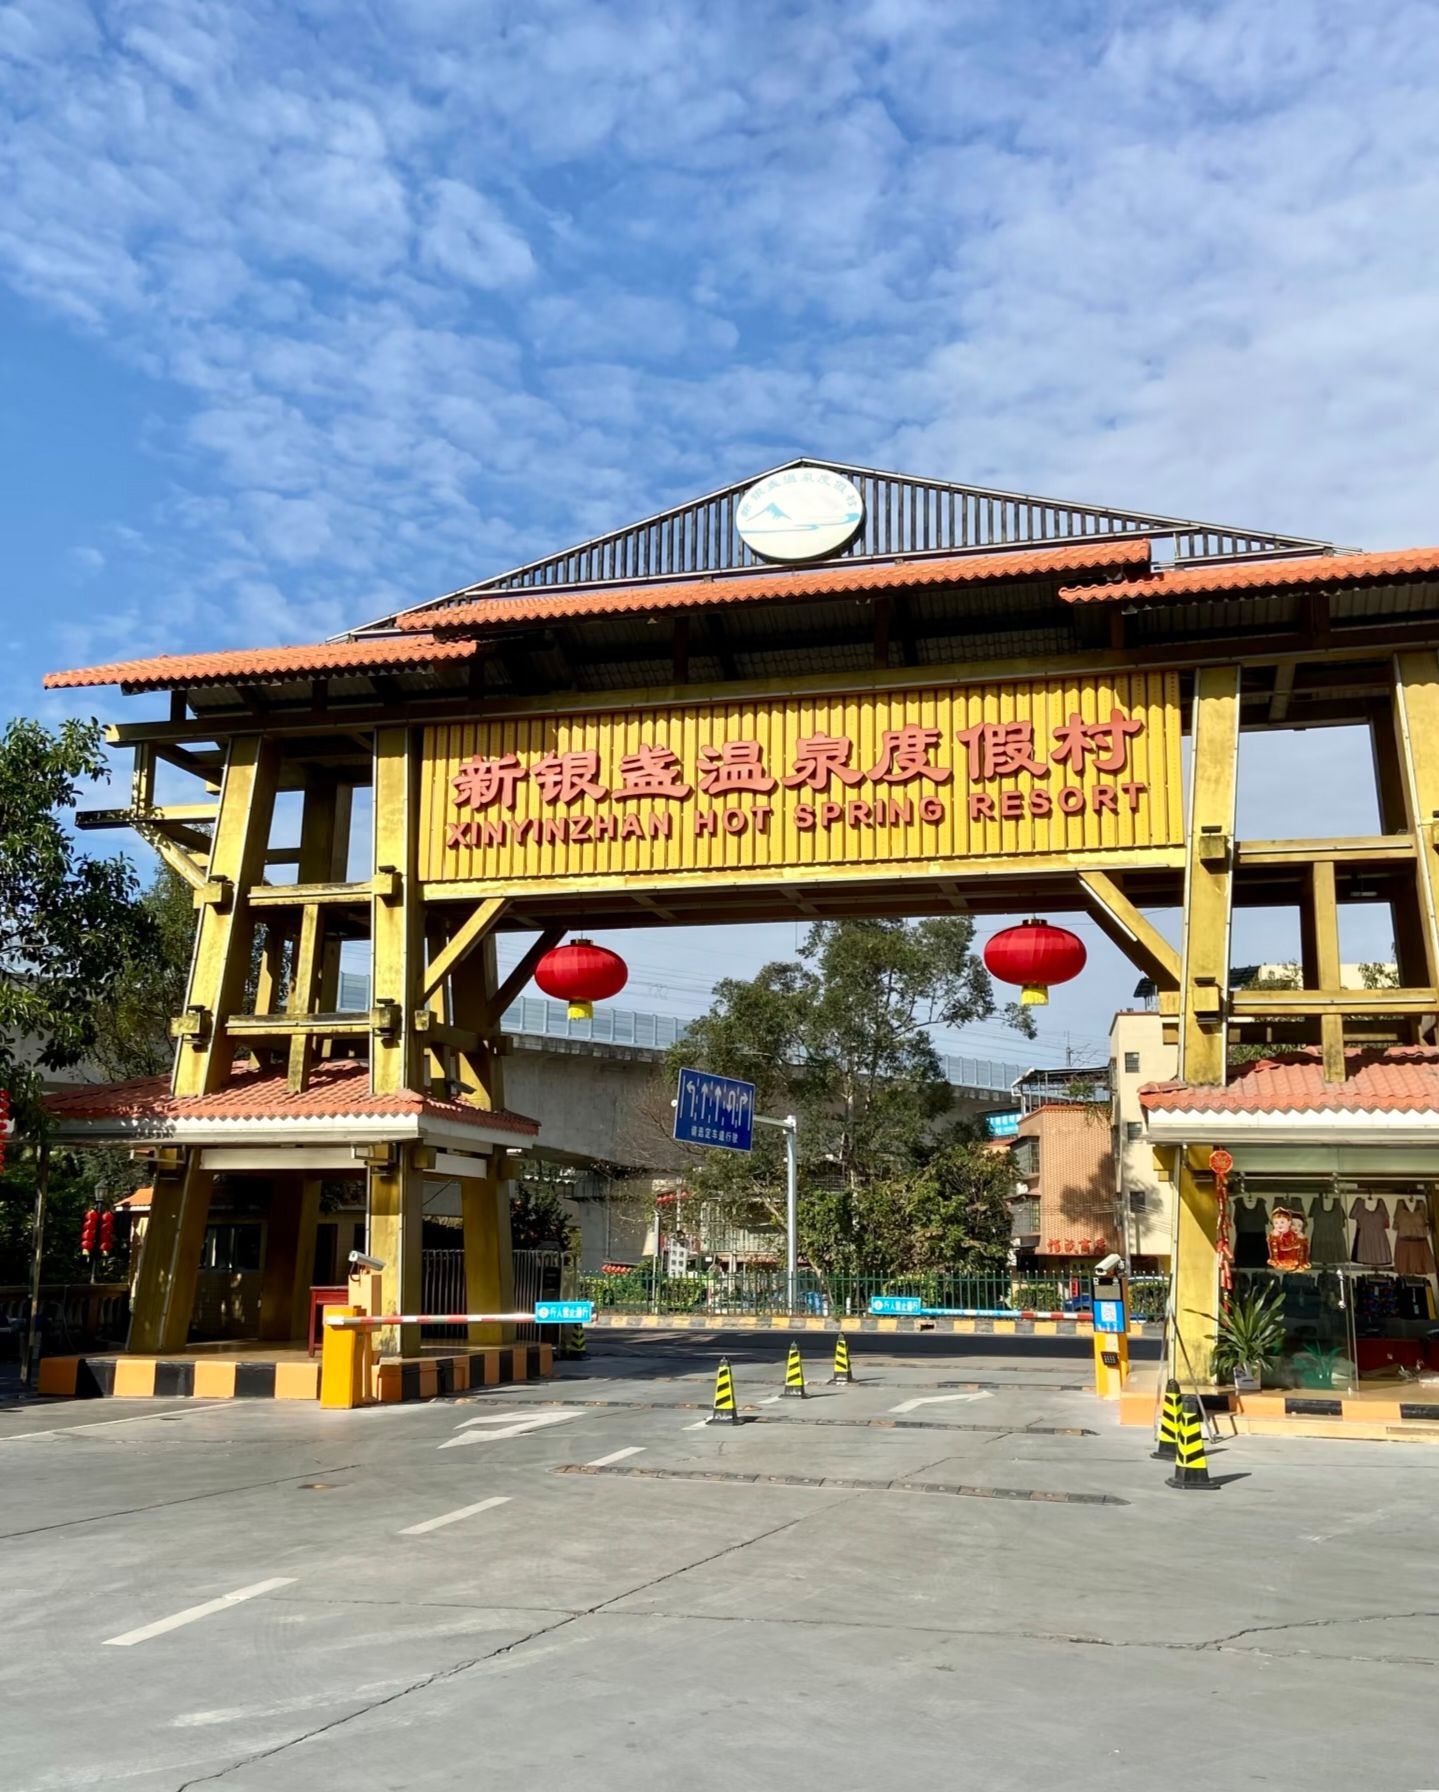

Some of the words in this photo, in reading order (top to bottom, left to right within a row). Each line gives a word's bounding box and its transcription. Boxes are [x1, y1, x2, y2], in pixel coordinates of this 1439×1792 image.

[451, 707, 1142, 809] 新银盏温泉度假村
[447, 811, 672, 848] XINYINZHAN
[694, 806, 773, 836] HOT
[794, 794, 946, 828] SPRING
[969, 782, 1146, 821] RESORT
